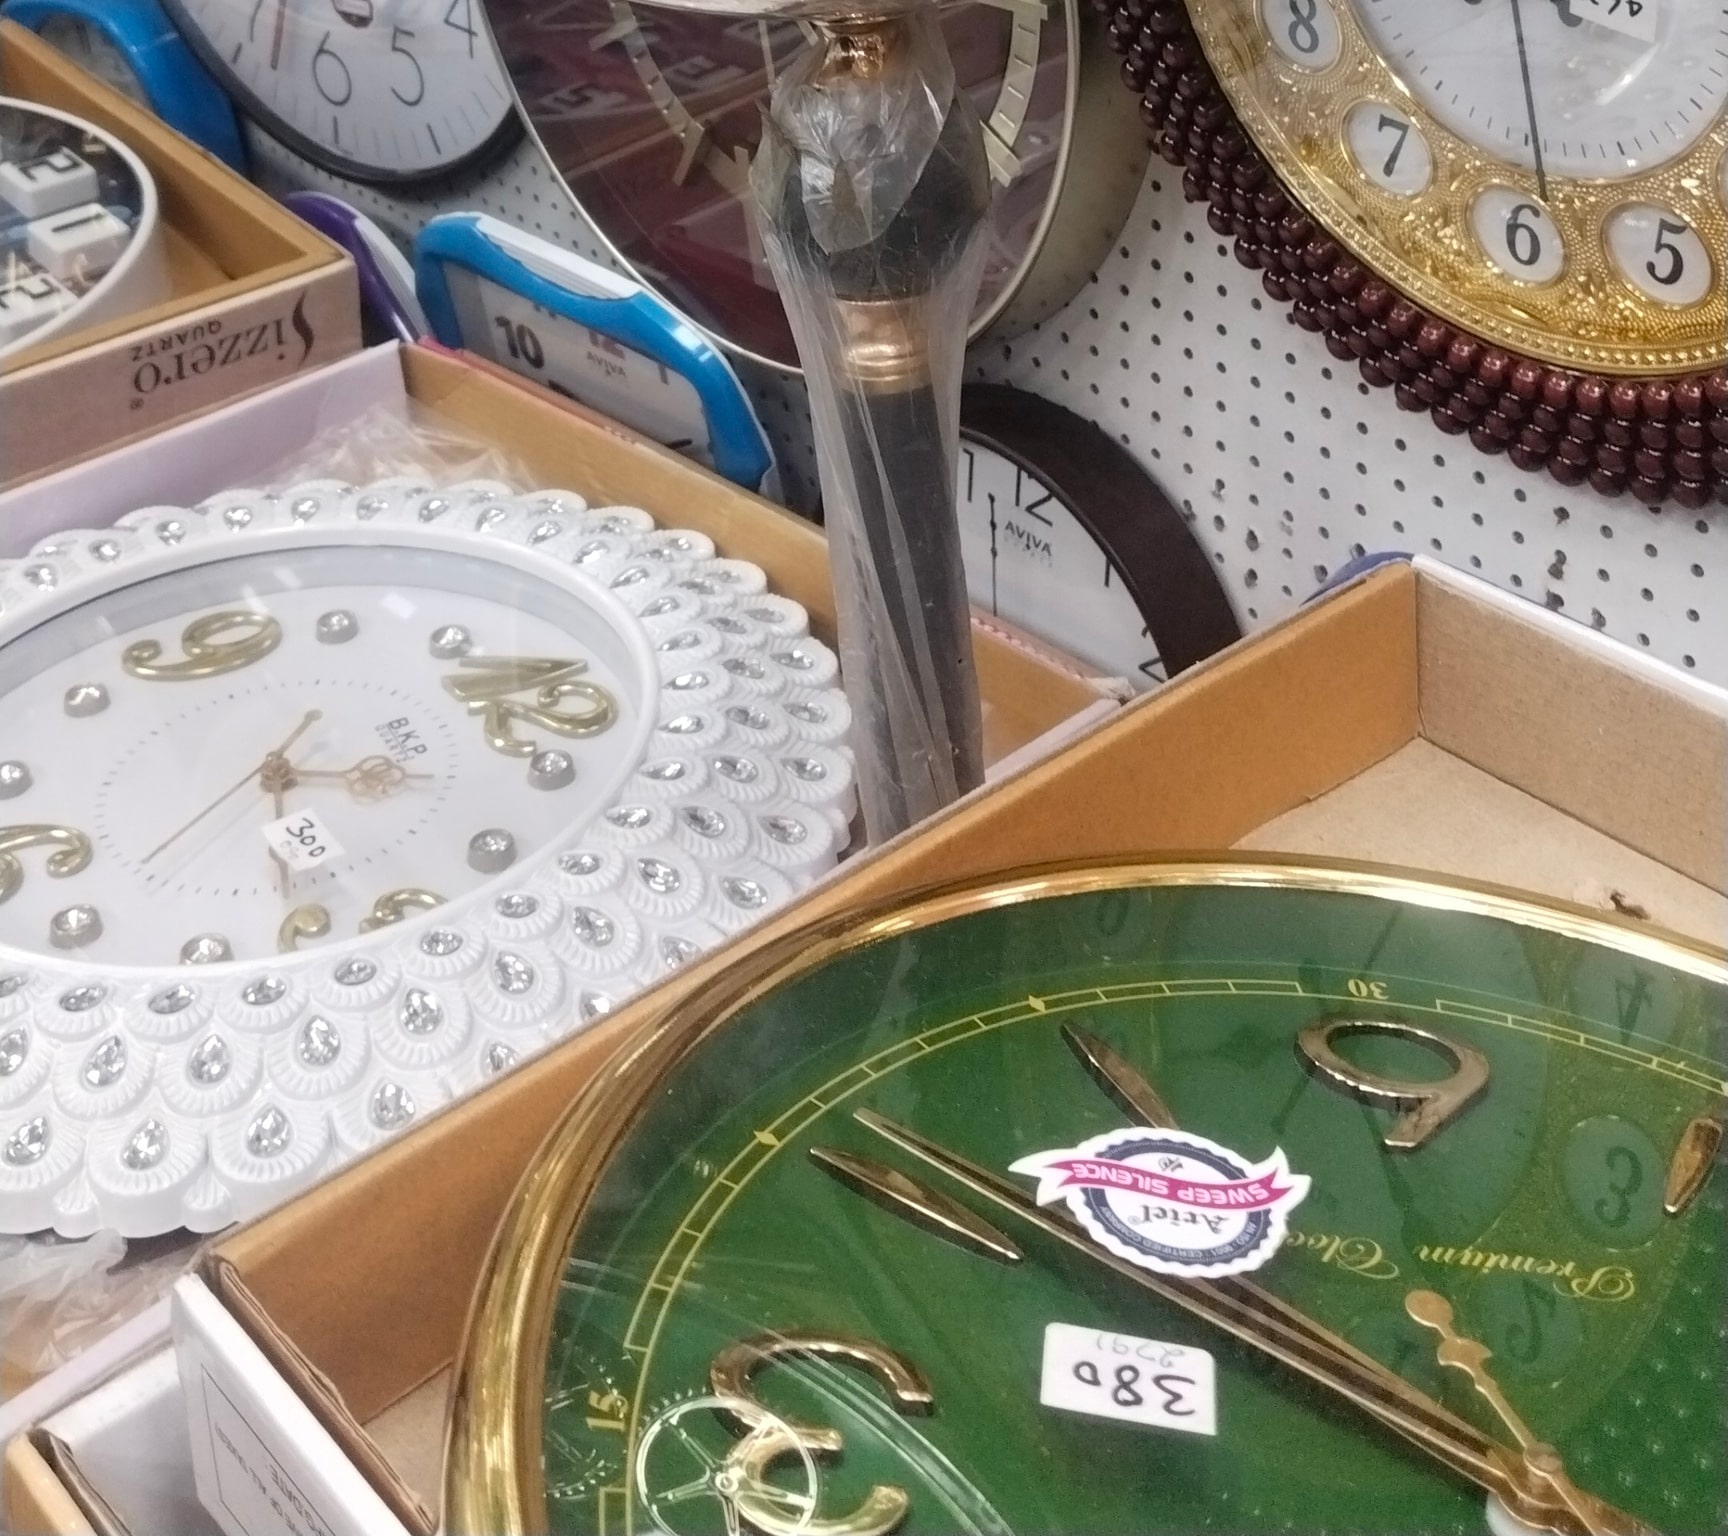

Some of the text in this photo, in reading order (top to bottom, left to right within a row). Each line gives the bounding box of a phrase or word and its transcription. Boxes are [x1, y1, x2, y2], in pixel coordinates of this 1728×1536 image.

[312, 30, 351, 106] 6
[390, 24, 424, 107] 5
[1377, 113, 1409, 178] 7
[1505, 203, 1541, 266] 6
[1646, 217, 1688, 285] 5
[131, 320, 222, 362] QUARTZ
[495, 316, 545, 369] 10
[1005, 519, 1052, 556] AVIVA
[286, 817, 326, 857] 300
[1347, 978, 1389, 1000] 30
[1071, 1162, 1169, 1195] SILENCE
[1177, 1182, 1270, 1206] SWEEP
[1413, 1244, 1635, 1302] Premium
[586, 1390, 629, 1431] 15
[1073, 1360, 1196, 1416] 380
